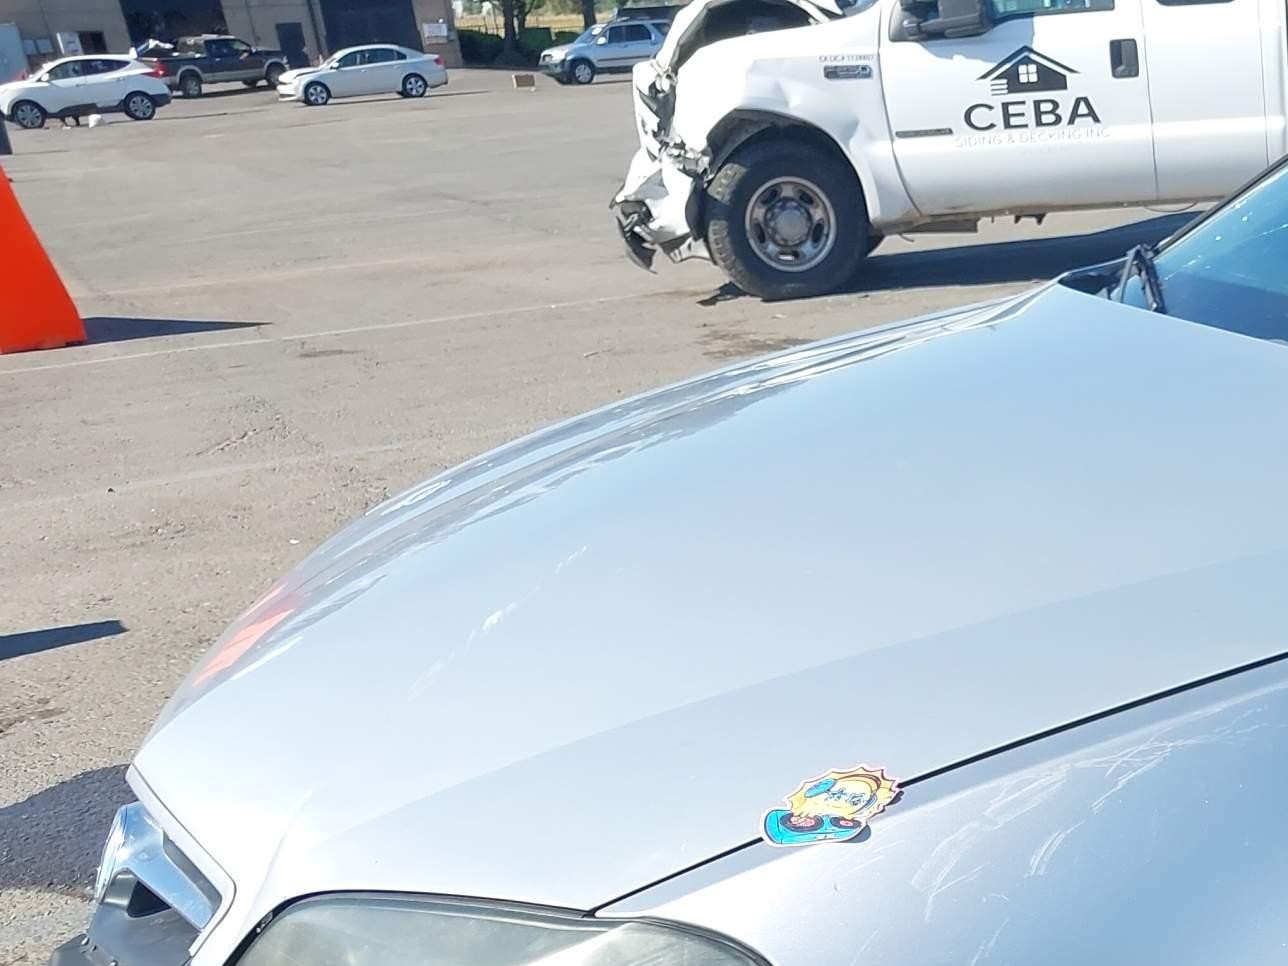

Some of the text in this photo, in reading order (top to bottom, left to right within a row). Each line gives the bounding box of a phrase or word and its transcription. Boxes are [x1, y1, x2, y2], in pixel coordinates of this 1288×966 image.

[964, 96, 1101, 131] CEBA
[955, 135, 1002, 148] SIDING
[1019, 130, 1082, 144] DECKING
[1086, 127, 1110, 139] INC
